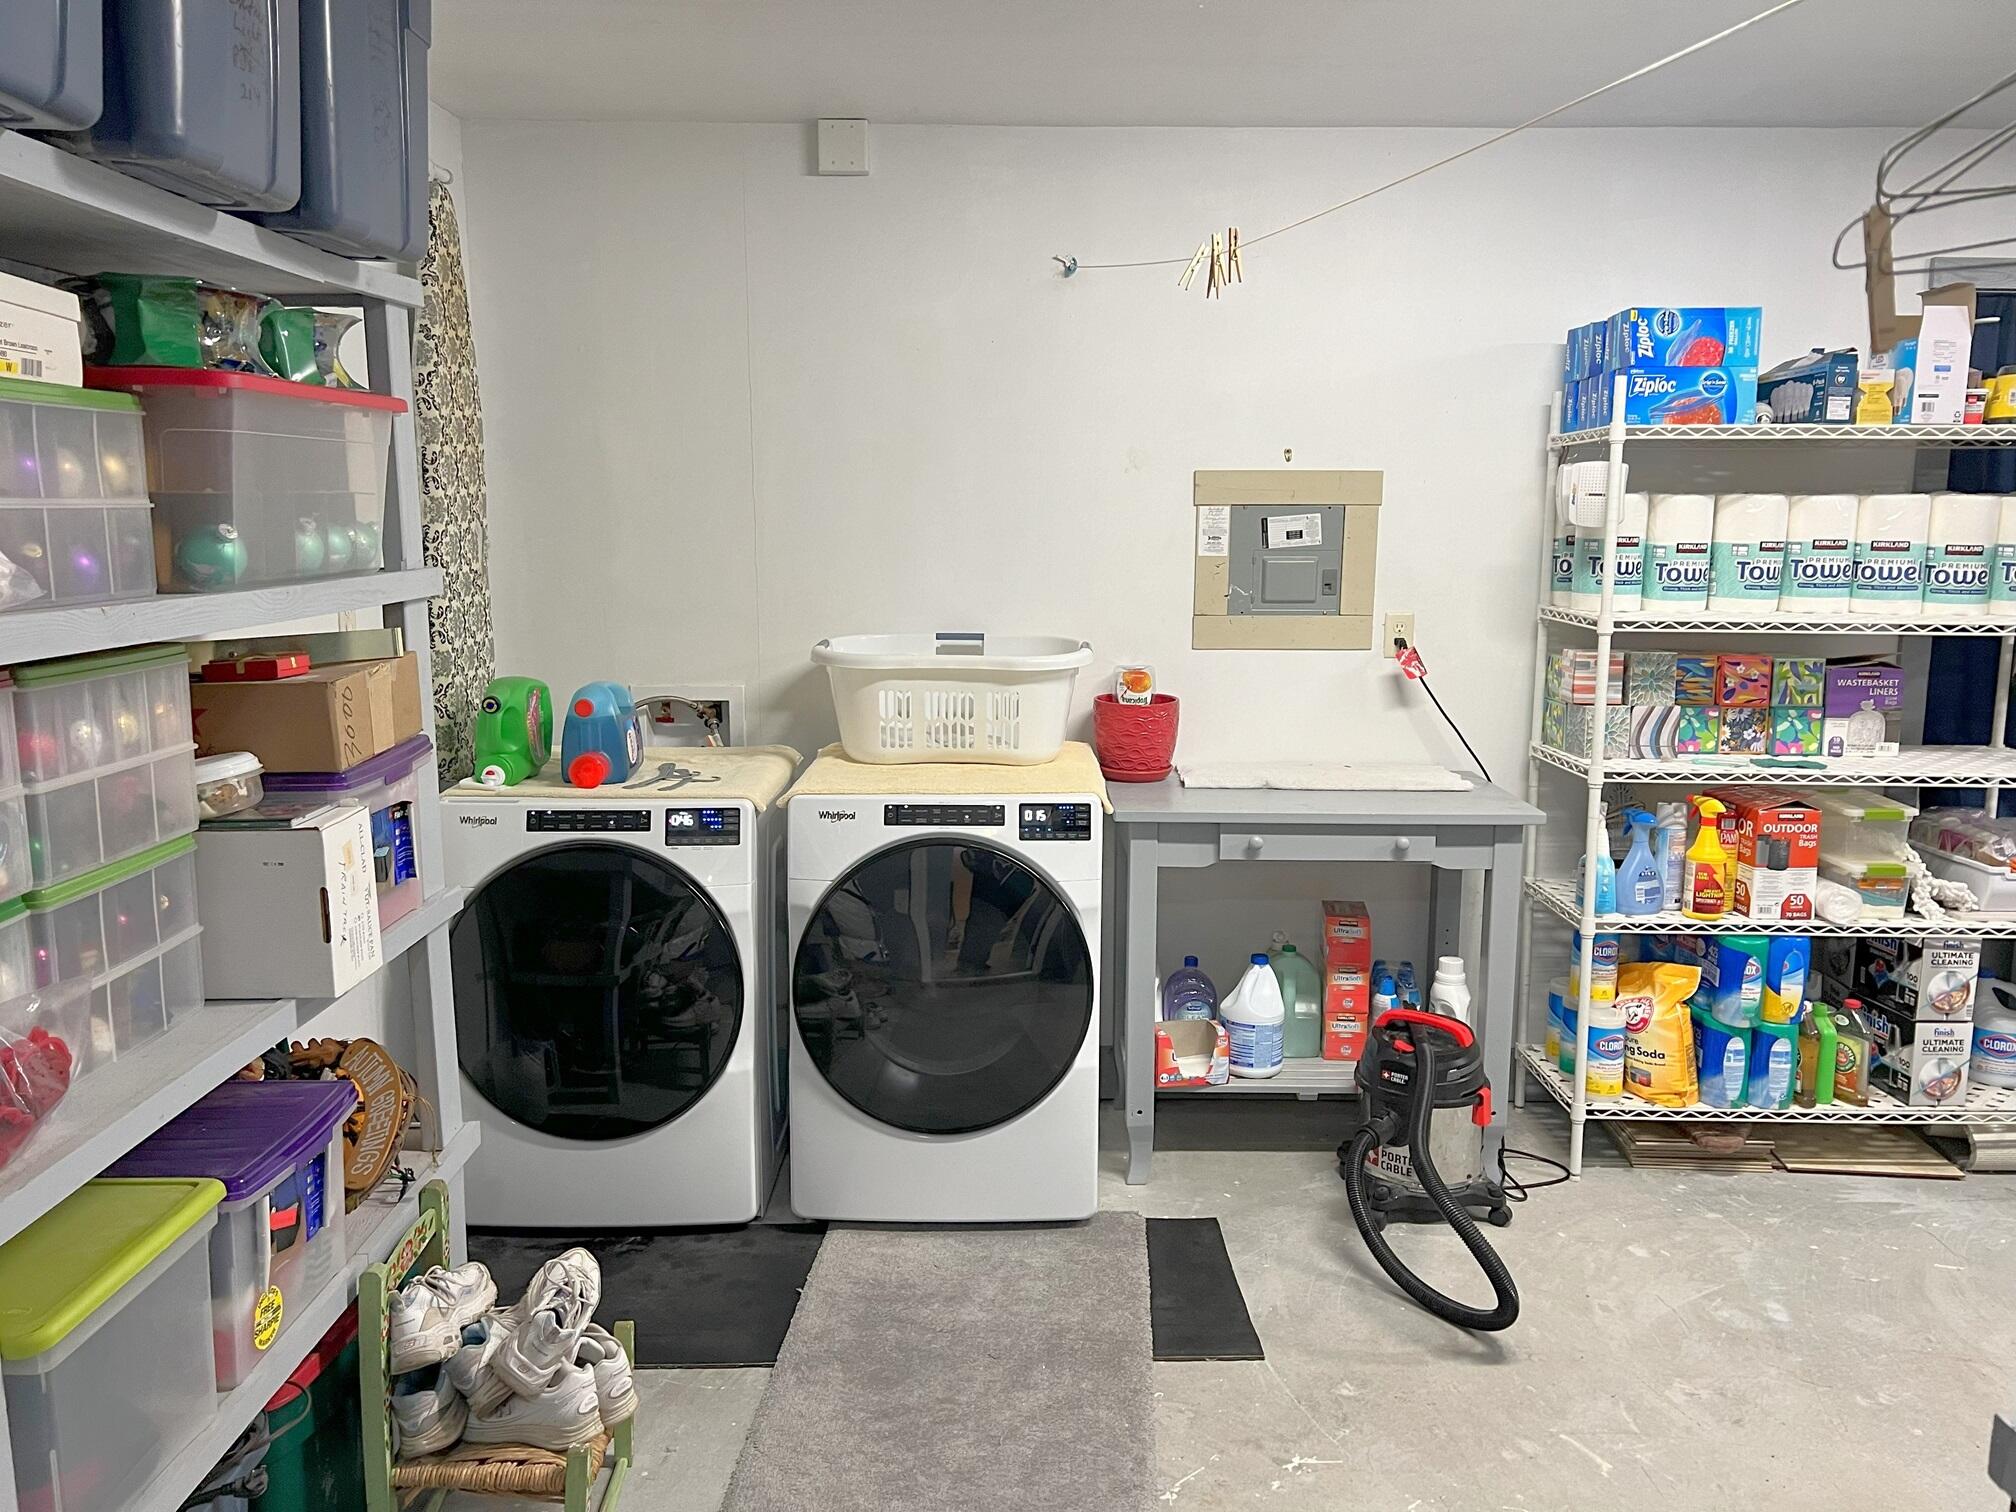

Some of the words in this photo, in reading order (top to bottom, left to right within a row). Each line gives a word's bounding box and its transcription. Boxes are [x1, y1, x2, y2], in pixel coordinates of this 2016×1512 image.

[1639, 318, 1655, 358] Ziploc
[6, 362, 12, 372] W
[1633, 377, 1676, 397] Ziploc
[1589, 557, 1642, 575] Twe
[1656, 562, 1708, 581] Towe
[1737, 561, 1780, 580] Tow
[1791, 560, 1851, 579] Towe
[1853, 560, 1922, 581] Towel
[1837, 679, 1900, 687] WASTEBASKET
[1869, 687, 1898, 696] LINERS
[459, 815, 498, 828] Whirlpool
[819, 809, 856, 823] Whirlpool
[1763, 823, 1818, 833] OUTDOOR
[1798, 839, 1817, 848] Bags
[1736, 881, 1746, 896] 50
[1790, 895, 1804, 906] 50
[1868, 937, 1898, 951] nish
[1943, 940, 1964, 950] finish
[1931, 951, 1974, 959] ULTIMATE
[1907, 972, 1918, 983] 100
[1866, 1009, 1889, 1034] nish
[1934, 1027, 1955, 1037] finish
[1922, 1039, 1965, 1047] ULTIMATE
[1983, 1038, 2016, 1052] CLOROX
[1637, 1046, 1665, 1060] Soda
[344, 1045, 394, 1097] AUTUMN
[1390, 1071, 1409, 1081] PORTER
[1390, 1076, 1406, 1085] CABLE
[351, 1089, 397, 1176] GREETINGS
[1381, 1149, 1413, 1166] PORT
[1381, 1160, 1413, 1177] CABLE
[254, 1312, 280, 1340] SHARPIE
